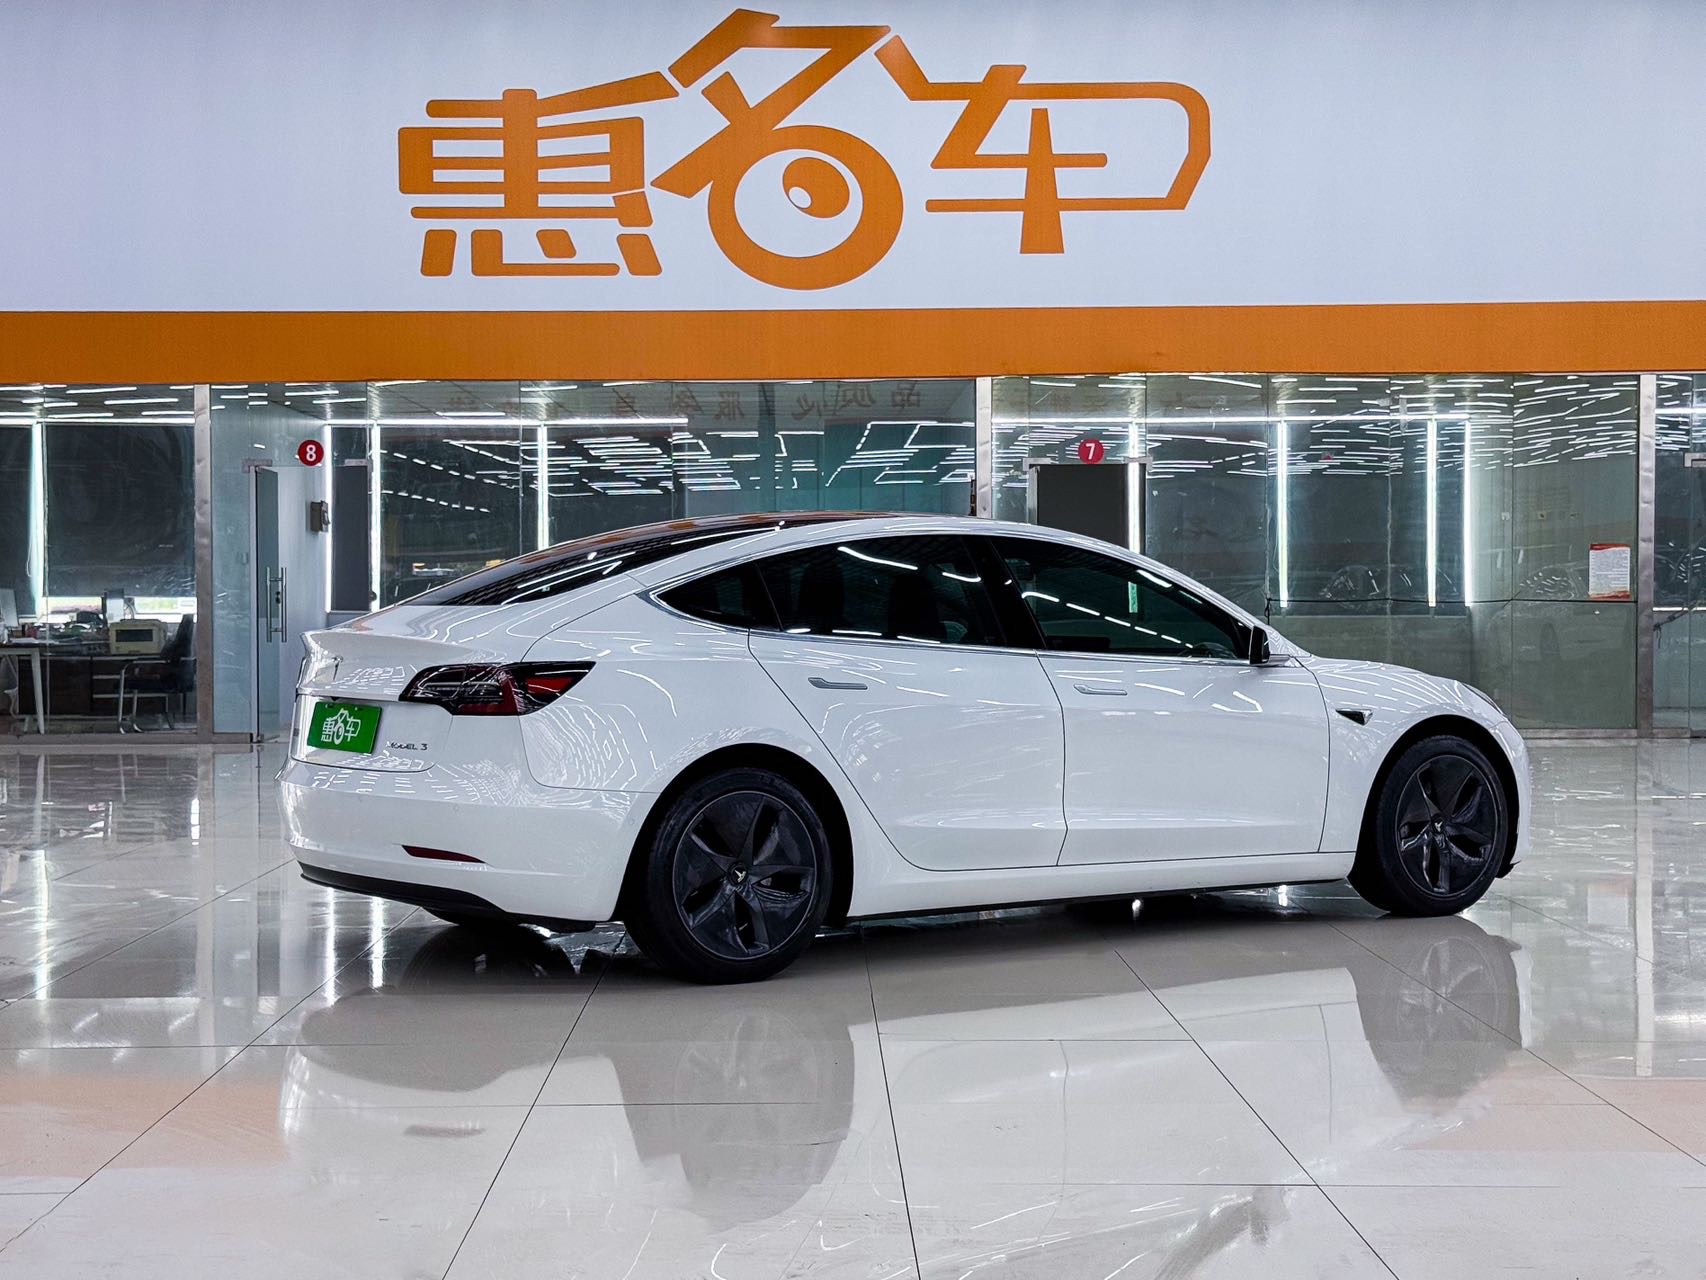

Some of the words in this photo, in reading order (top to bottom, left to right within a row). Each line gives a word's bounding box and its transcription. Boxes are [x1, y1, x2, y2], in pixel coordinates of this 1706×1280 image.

[397, 8, 1211, 290] 惠名车
[306, 444, 316, 462] 8
[1085, 442, 1096, 460] 7
[321, 708, 361, 745] 惠名车
[420, 742, 428, 751] 3
